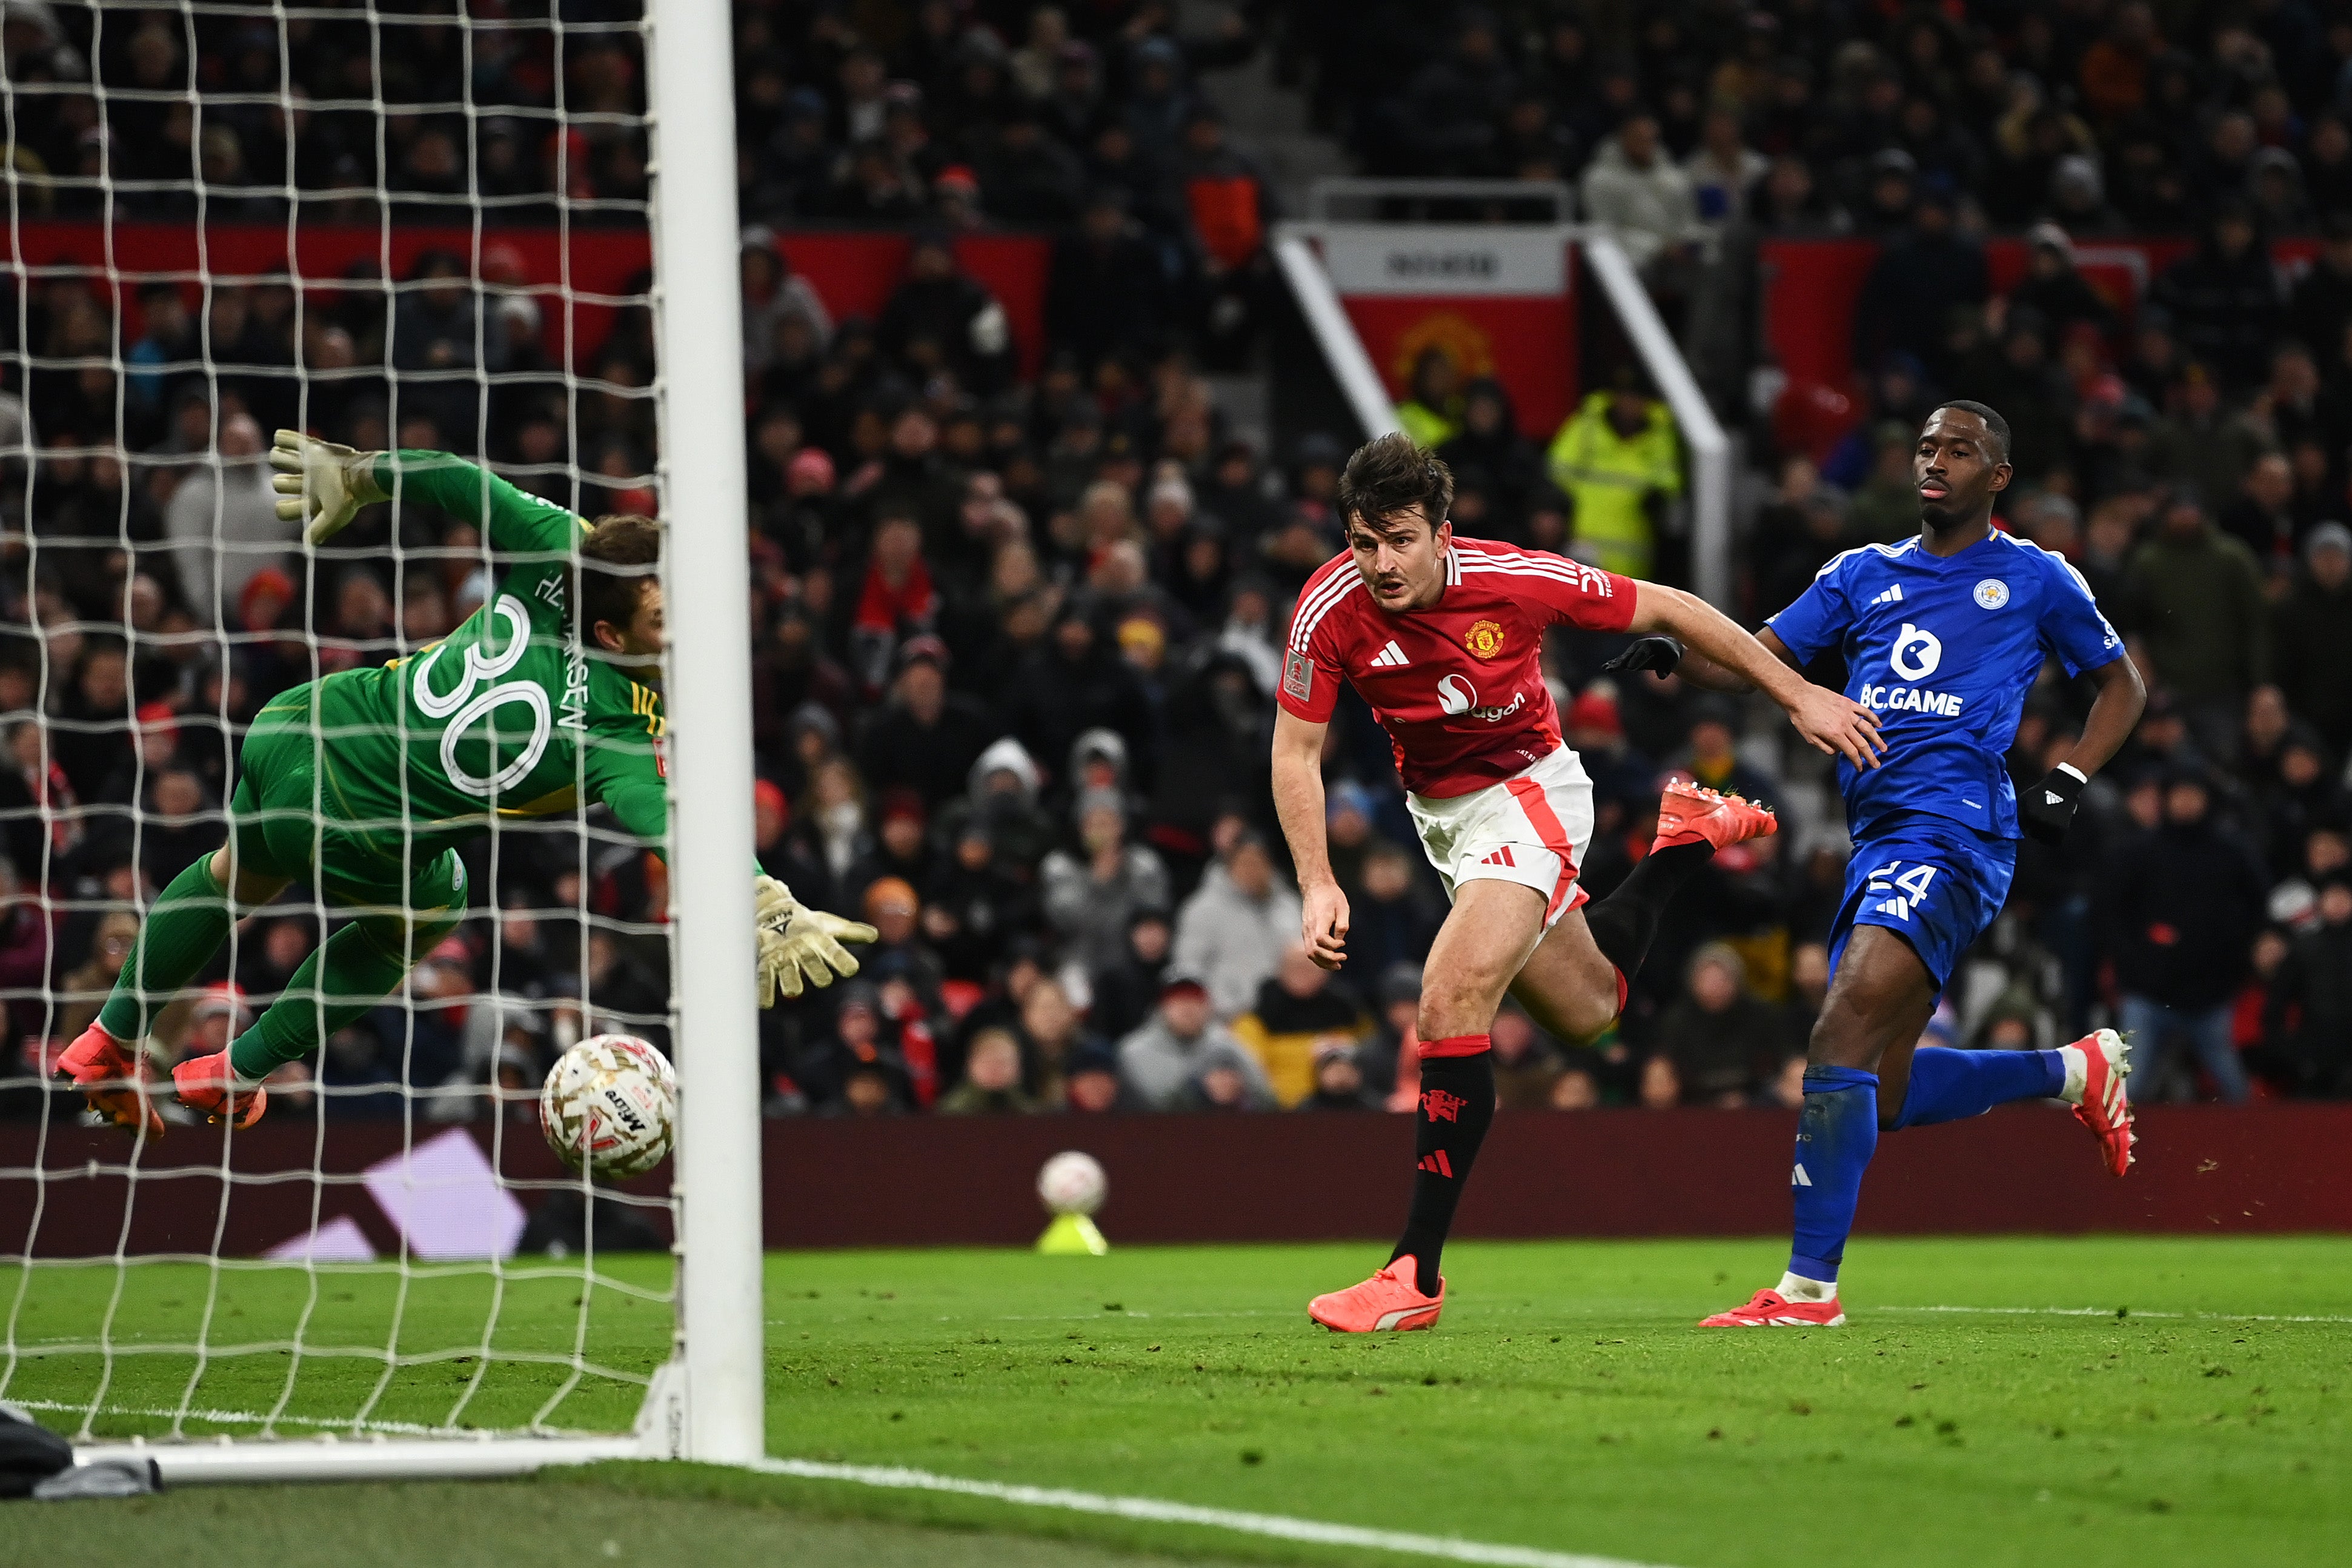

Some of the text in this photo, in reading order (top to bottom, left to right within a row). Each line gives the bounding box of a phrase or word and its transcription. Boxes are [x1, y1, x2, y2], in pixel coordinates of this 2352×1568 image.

[413, 594, 551, 797] 30
[1859, 683, 1964, 717] BC.GAME
[1868, 860, 1938, 908] 24
